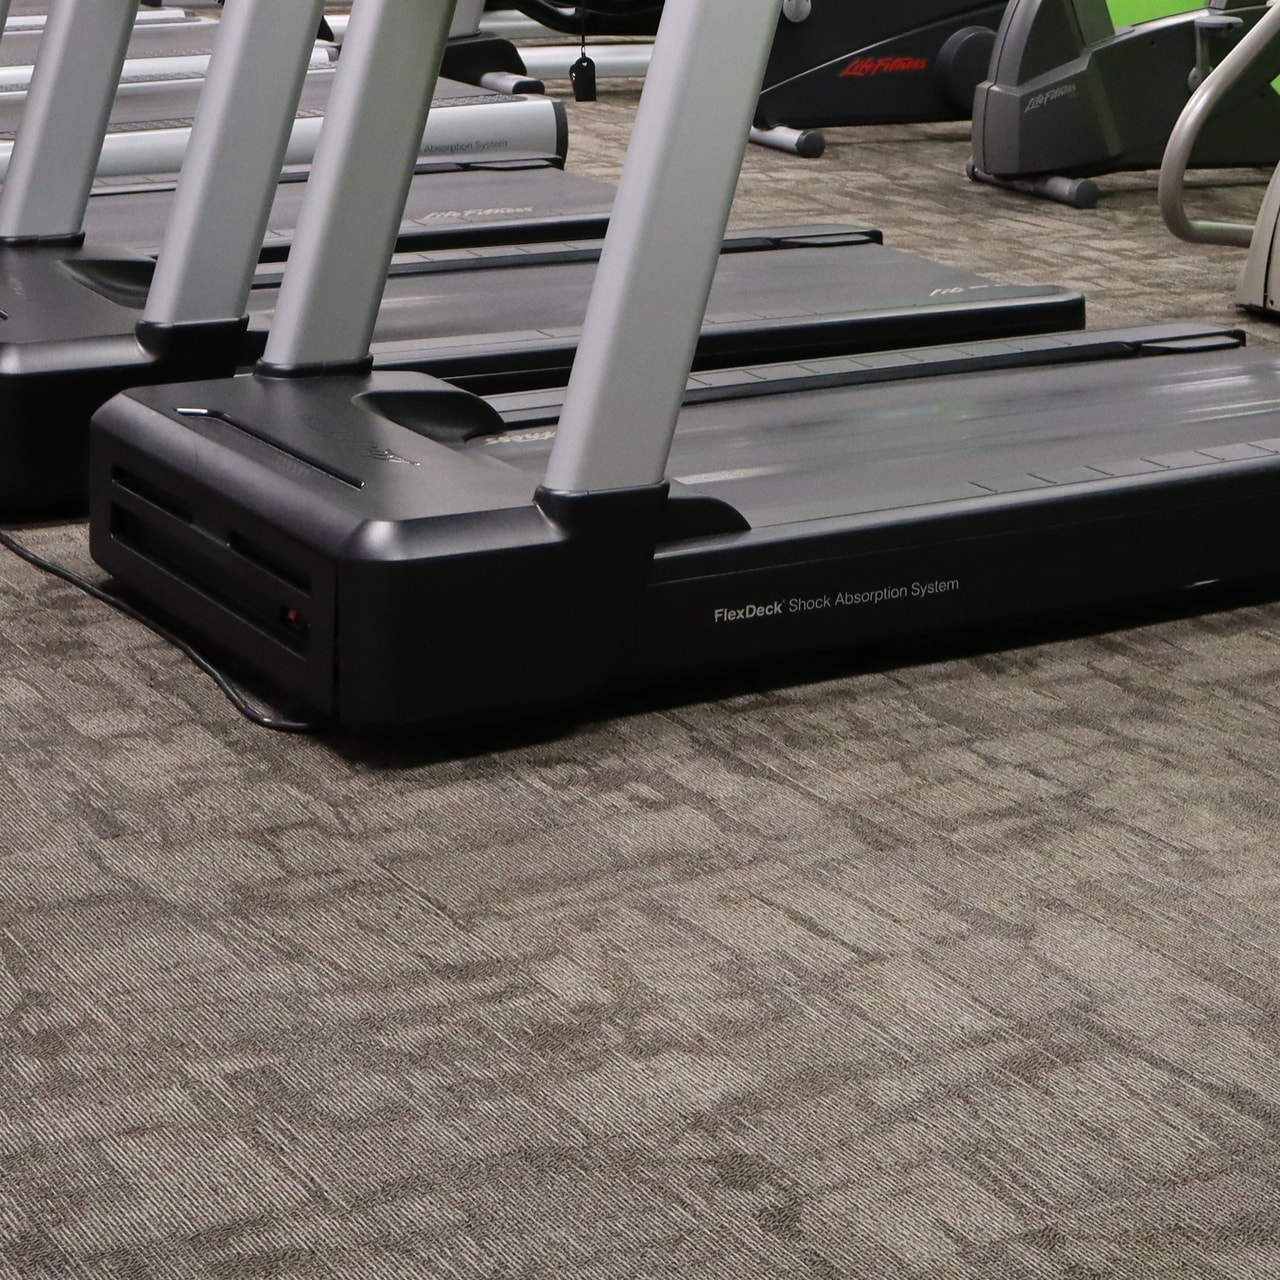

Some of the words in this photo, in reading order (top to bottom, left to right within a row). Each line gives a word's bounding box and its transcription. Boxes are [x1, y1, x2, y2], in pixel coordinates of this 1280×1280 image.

[714, 600, 783, 623] FlexDeck
[788, 594, 832, 613] Shock
[834, 585, 908, 607] Absorption
[911, 578, 960, 598] System
